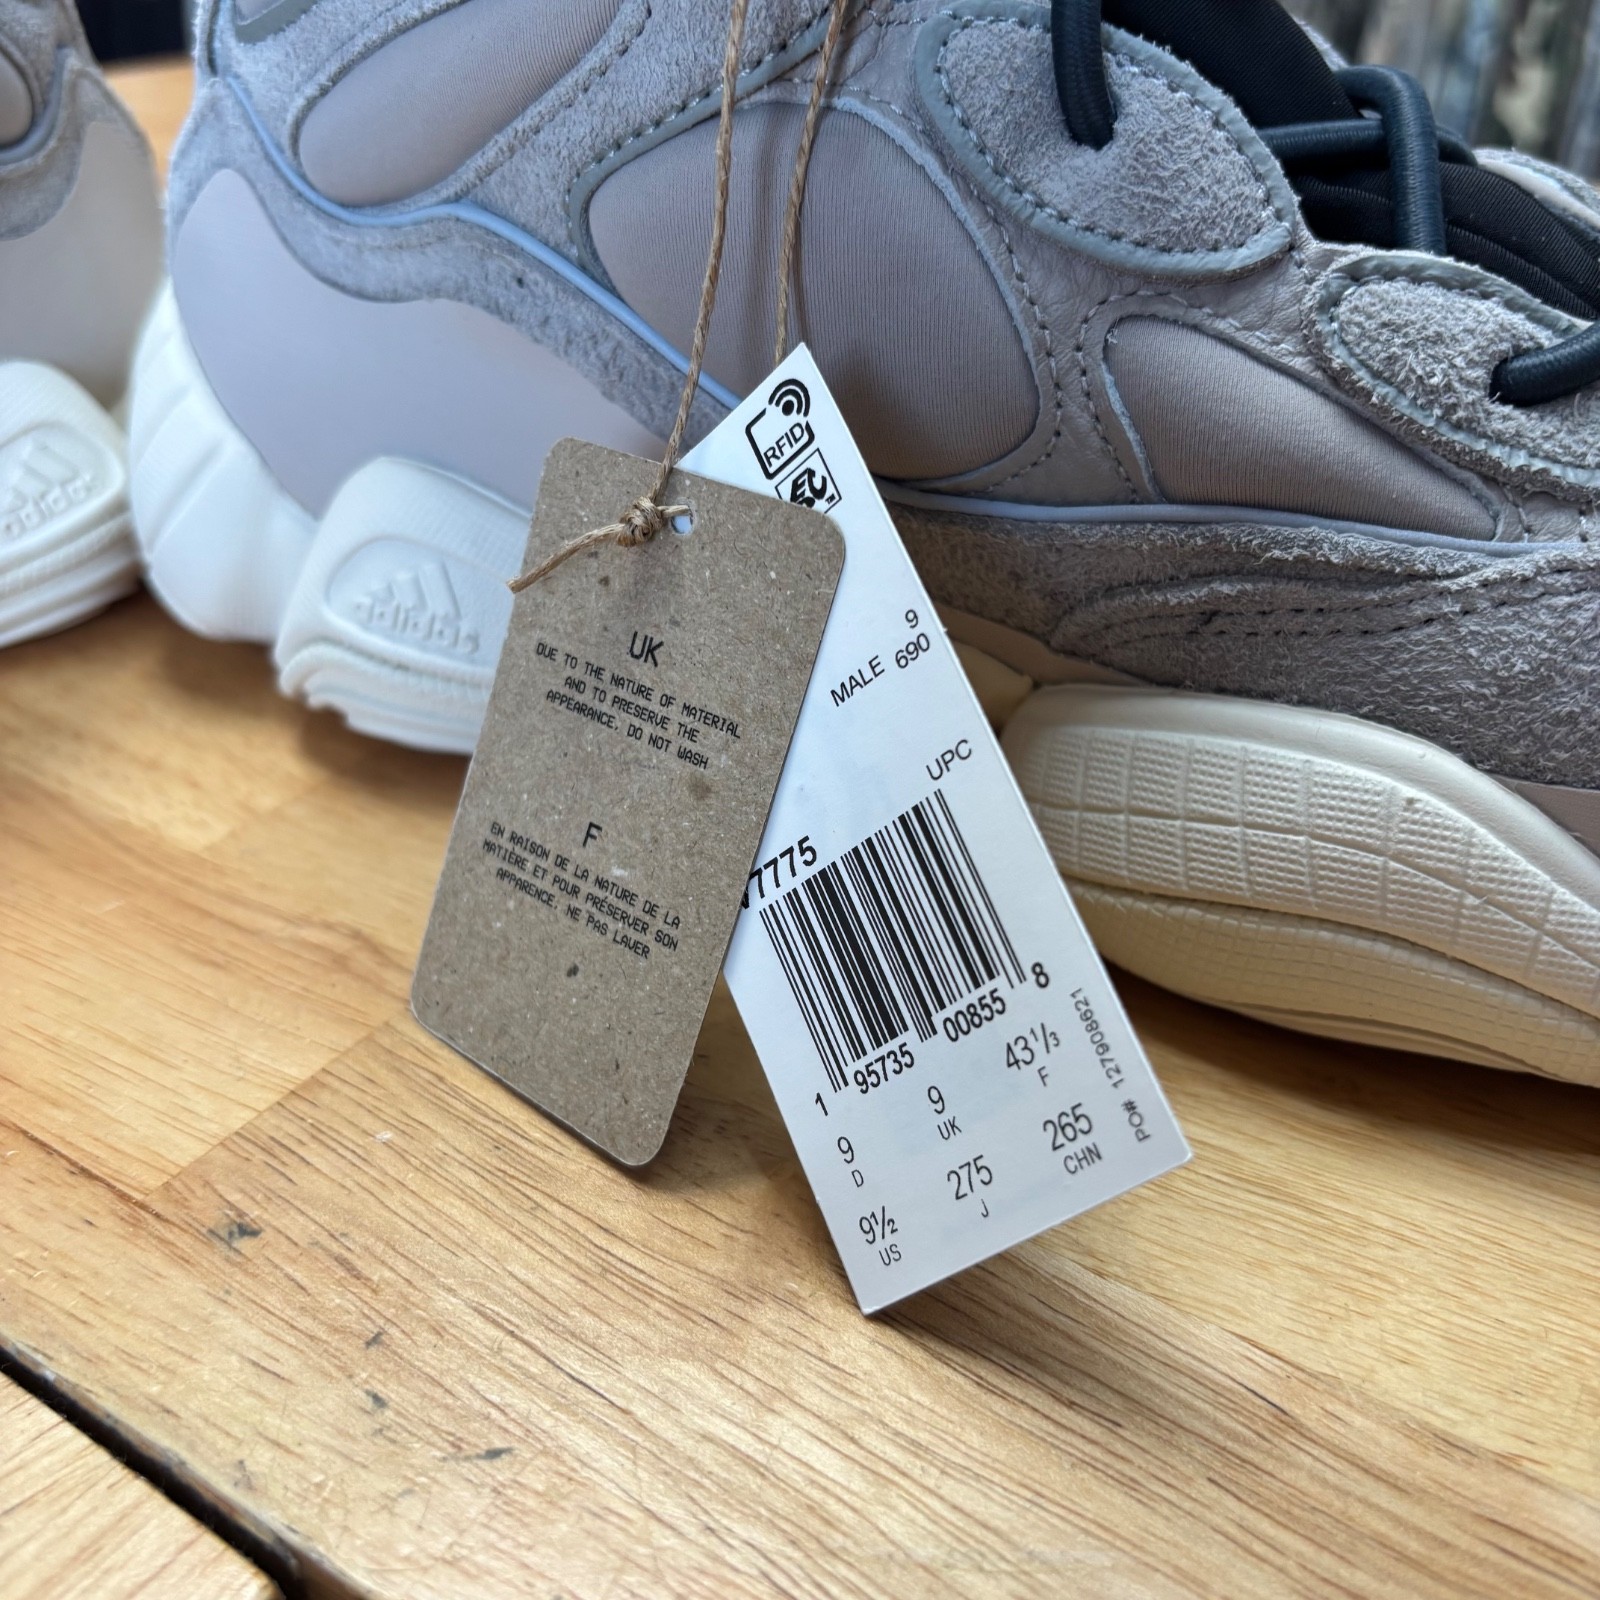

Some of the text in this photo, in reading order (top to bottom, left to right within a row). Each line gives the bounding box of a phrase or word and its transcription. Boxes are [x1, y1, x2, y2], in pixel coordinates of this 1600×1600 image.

[763, 422, 805, 468] RFID
[350, 598, 480, 656] adidas
[904, 608, 919, 629] 9
[629, 630, 665, 668] UK
[830, 632, 930, 708] MALE 690
[536, 642, 741, 739] DUE TO THE NATURE OF MATERIAL
[564, 676, 700, 744] AND TO PRESERVE THE
[546, 689, 709, 770] APPEARANCE, DO NOT WASH
[926, 739, 972, 781] UPC
[582, 821, 602, 848] F
[490, 821, 681, 930] EN RAISON DE LA NATURE DE LA
[496, 867, 651, 960] APPARENCE, NE PAS LAVER
[532, 864, 548, 881] ET
[551, 874, 581, 899] POUR
[654, 929, 679, 953] SON
[814, 961, 1050, 1117] 1 95735 00855 8
[1037, 1065, 1049, 1087] F
[1069, 986, 1152, 1144] PO# 127908621
[927, 1085, 946, 1115] 9
[937, 1116, 962, 1141] UK
[1043, 1102, 1093, 1151] 265
[837, 1136, 855, 1164] 9
[1063, 1142, 1102, 1175] CHN
[851, 1169, 865, 1188] D
[947, 1154, 994, 1201] 275
[981, 1198, 990, 1218] J
[878, 1243, 902, 1267] US
